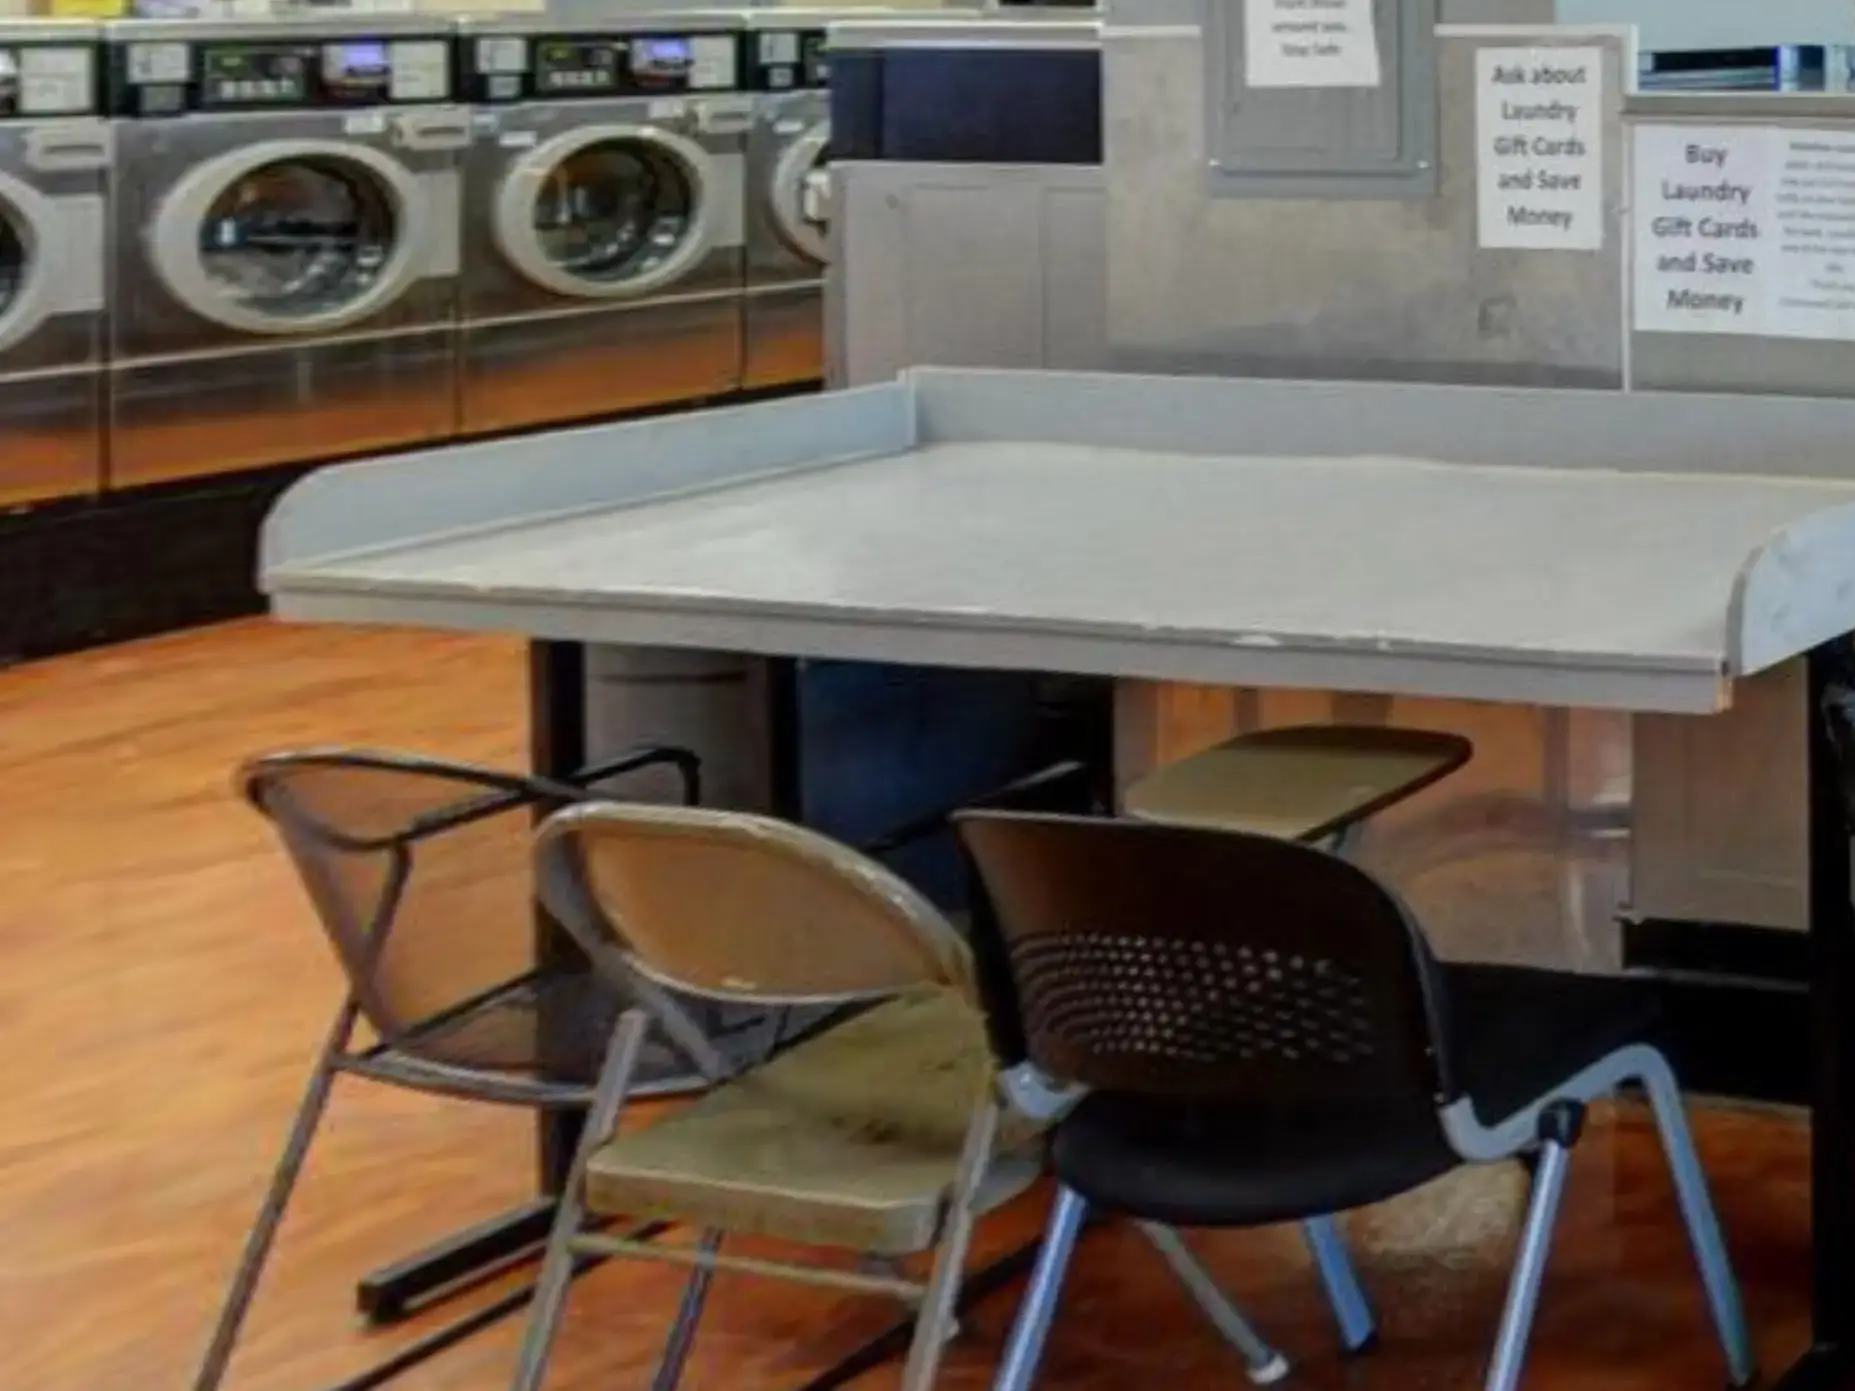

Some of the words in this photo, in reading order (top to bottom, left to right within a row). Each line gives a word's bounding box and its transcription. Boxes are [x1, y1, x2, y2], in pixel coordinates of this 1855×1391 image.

[1491, 64, 1525, 84] Ask
[1530, 65, 1586, 84] about
[1502, 100, 1580, 124] Laundry
[1493, 134, 1528, 156] Gift
[1531, 135, 1586, 156] Cards
[1685, 144, 1728, 169] Buy
[1497, 169, 1532, 190] and
[1537, 169, 1582, 190] Save
[1661, 179, 1751, 204] Laundry
[1507, 204, 1573, 231] Money
[1652, 215, 1692, 238] Gift
[1698, 216, 1759, 238] Cards
[1656, 252, 1696, 272] and
[1701, 252, 1754, 275] Save
[1667, 289, 1743, 315] Money
